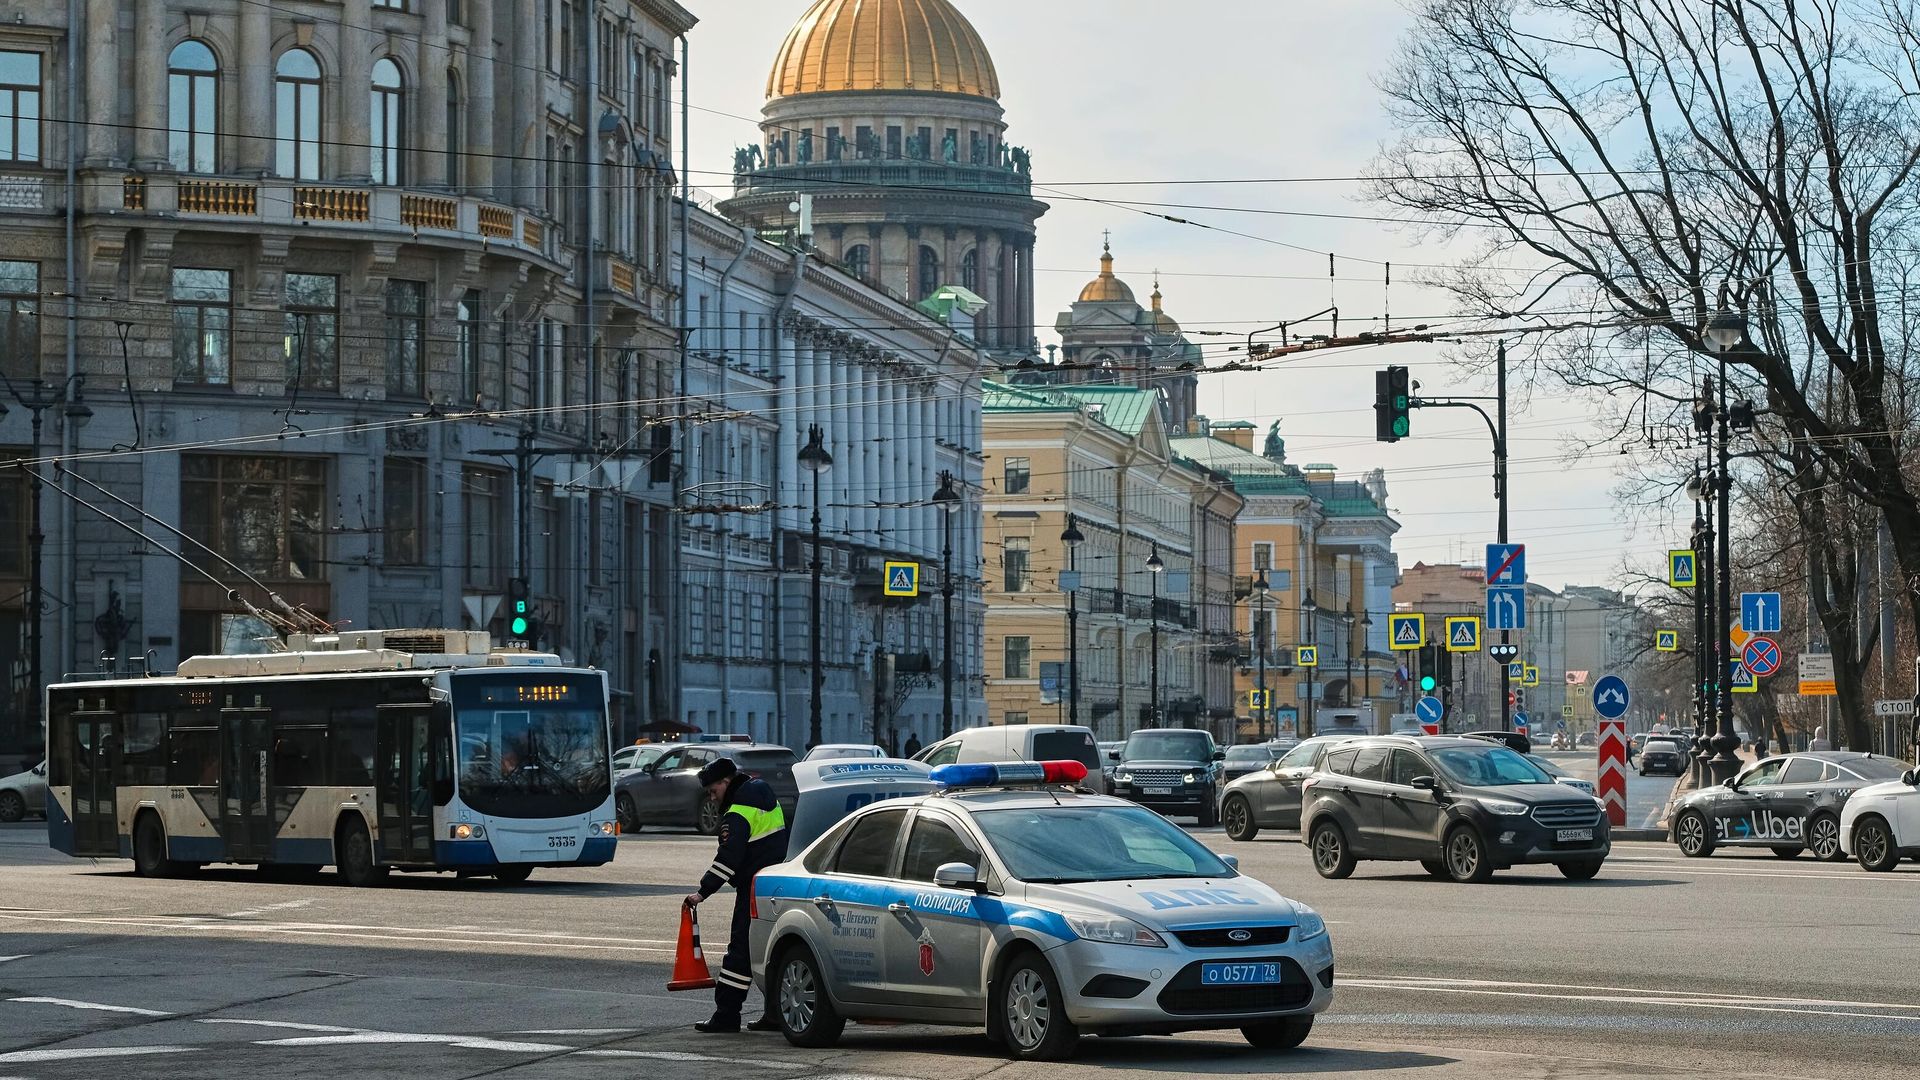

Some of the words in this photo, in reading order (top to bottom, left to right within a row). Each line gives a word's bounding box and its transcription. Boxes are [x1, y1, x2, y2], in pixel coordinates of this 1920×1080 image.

[1881, 702, 1911, 713] СТОП
[1751, 810, 1807, 838] Uber
[548, 836, 576, 847] 3335
[914, 893, 972, 914] ПОЛИЦИЯ
[1136, 889, 1259, 910] ДПС
[1223, 965, 1257, 981] 0577
[1264, 964, 1276, 976] 78
